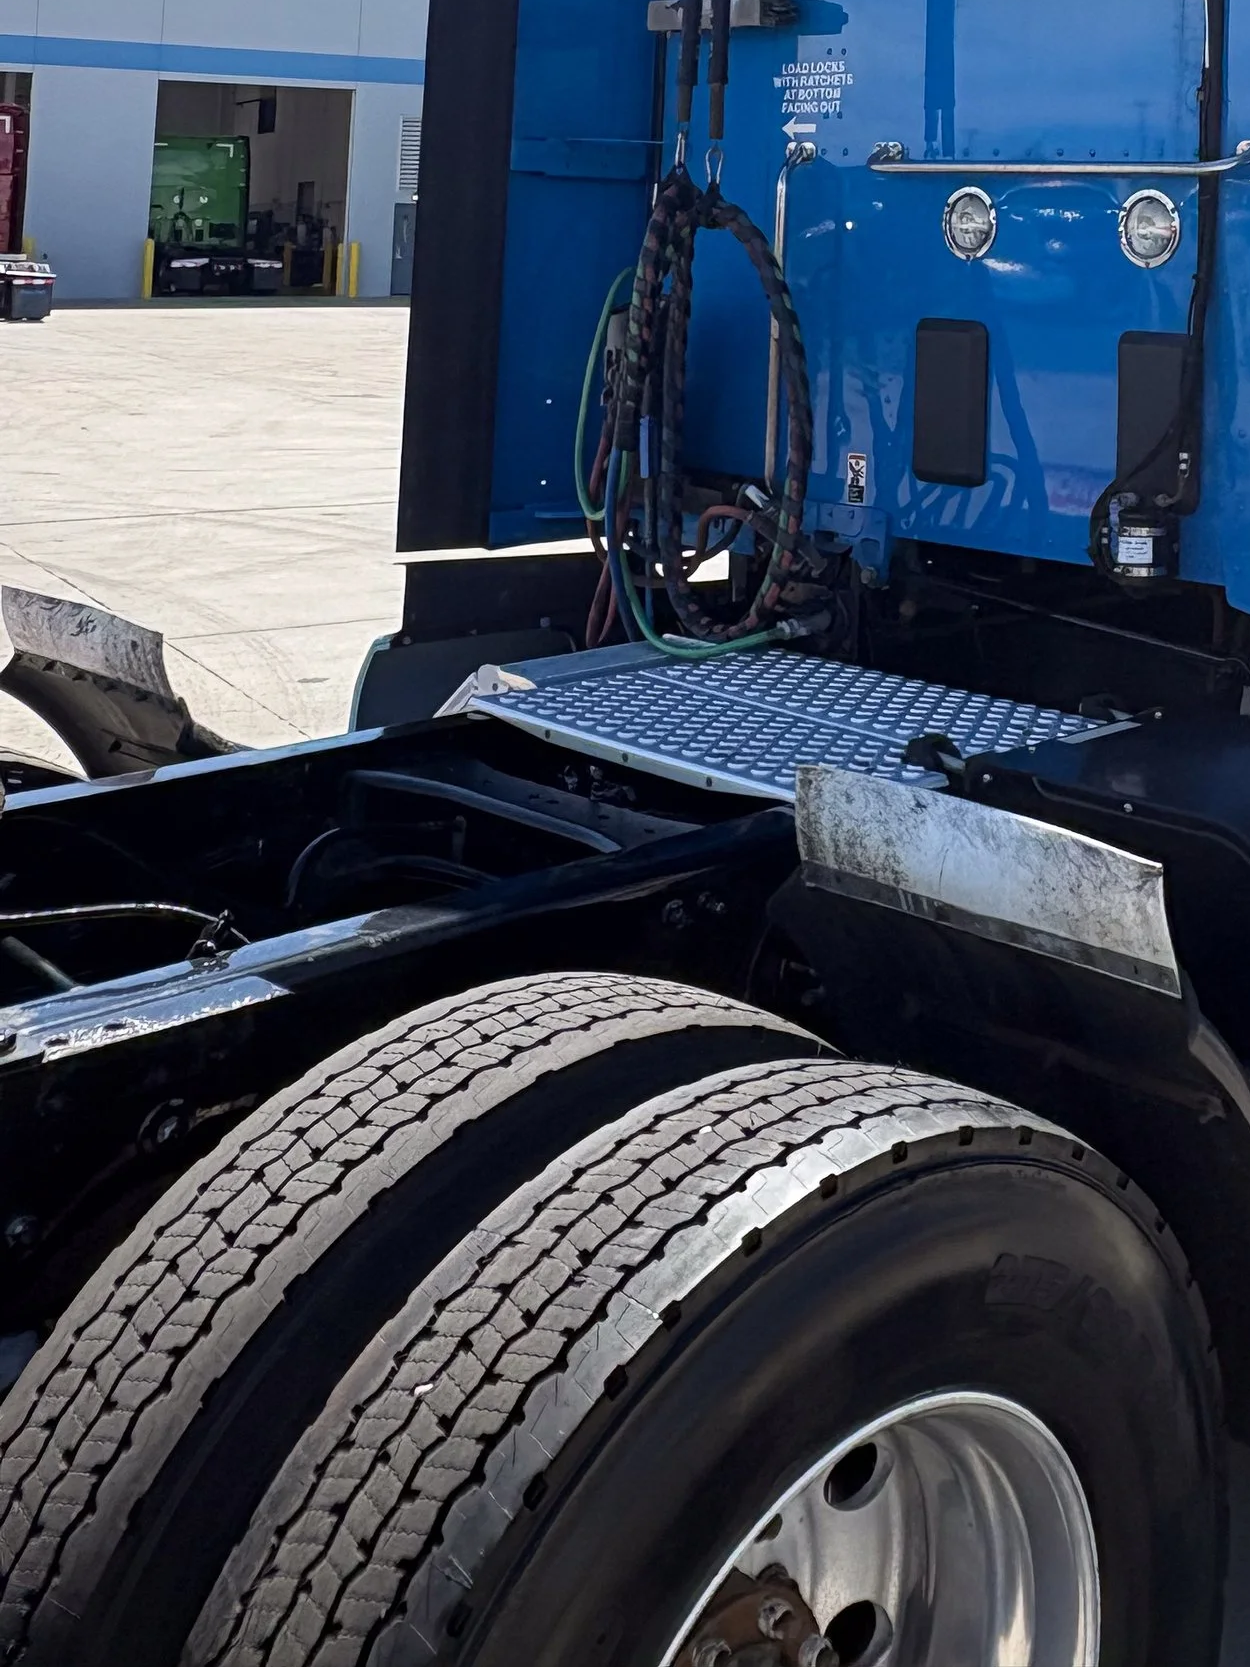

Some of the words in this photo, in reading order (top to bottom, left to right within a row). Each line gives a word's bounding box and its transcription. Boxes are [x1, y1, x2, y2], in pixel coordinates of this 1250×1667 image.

[782, 62, 809, 74] LOAD
[811, 61, 845, 74] LOCKS
[773, 76, 799, 89] WITH
[800, 74, 853, 87] RATCHETS
[784, 89, 797, 100] AT
[798, 88, 841, 100] BOTTOM
[781, 101, 818, 113] FACING
[820, 101, 841, 113] OUT
